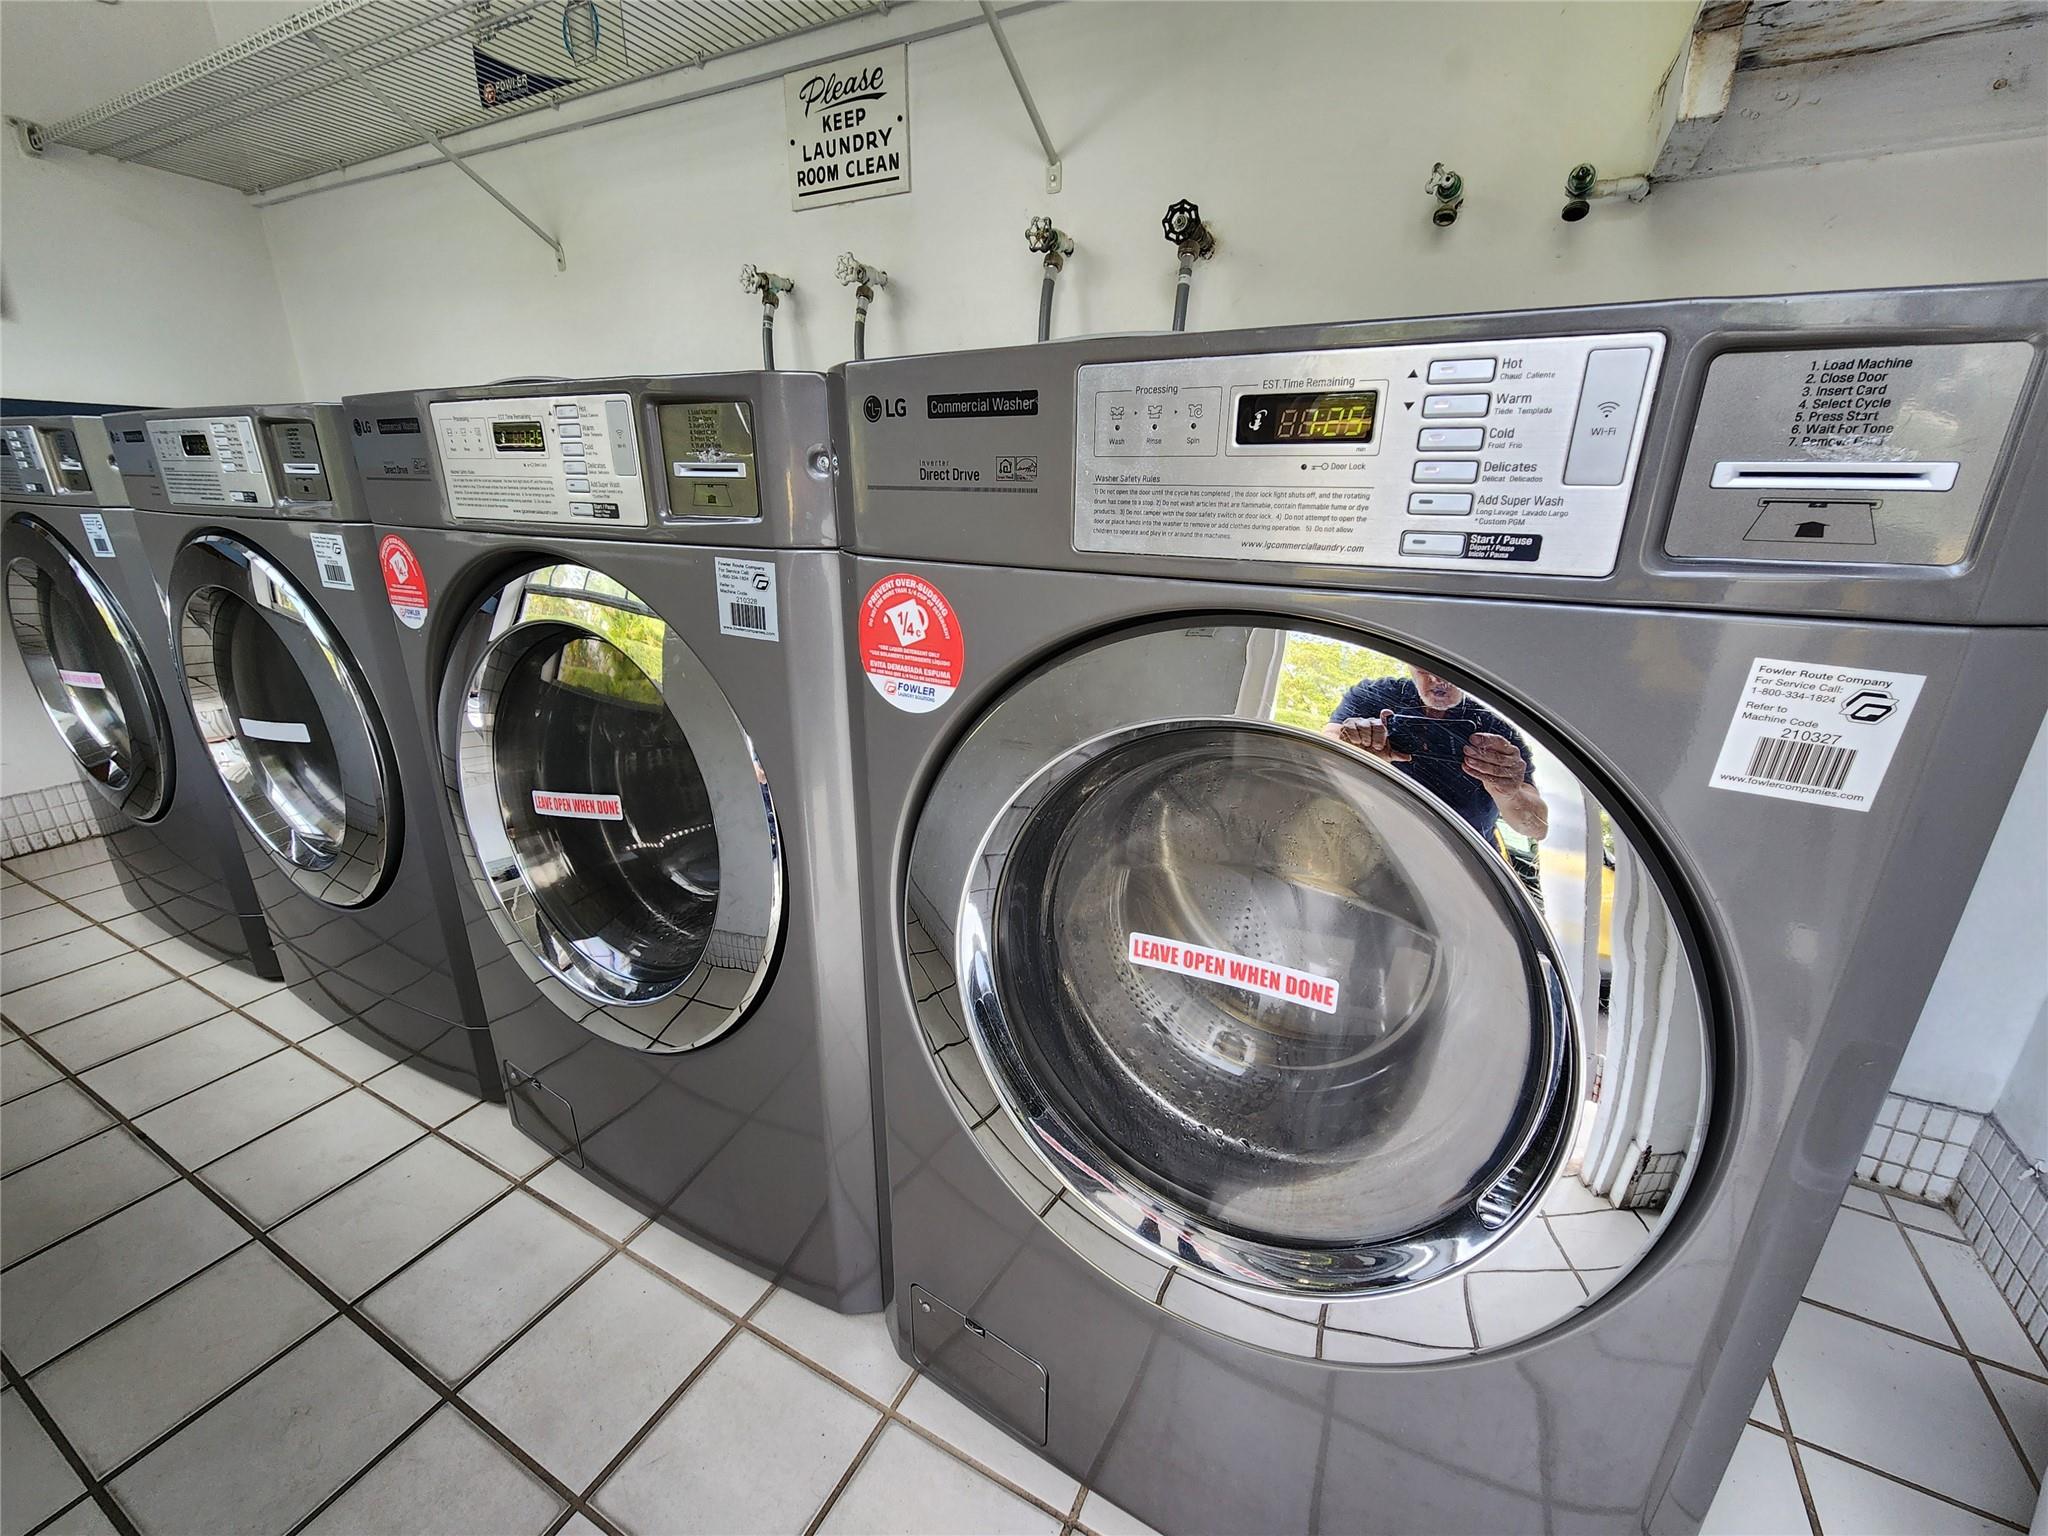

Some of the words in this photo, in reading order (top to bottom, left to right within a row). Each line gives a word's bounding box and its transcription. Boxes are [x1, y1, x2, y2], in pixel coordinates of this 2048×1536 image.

[799, 67, 884, 118] Please
[822, 108, 866, 133] KEEP
[803, 127, 892, 162] LAUNDRY
[798, 164, 839, 187] ROOM
[846, 152, 899, 178] CLEAN
[1502, 358, 1523, 369] Hot
[1811, 361, 1820, 371] 1.
[1823, 360, 1855, 370] Load
[1857, 358, 1913, 369] Machine
[1526, 371, 1556, 379] Caliente
[1805, 374, 1816, 384] 2.
[1820, 373, 1854, 384] Close
[1857, 372, 1888, 382] Door
[1306, 377, 1355, 387] Remaining
[1136, 384, 1178, 395] Processing
[1802, 387, 1812, 396] 3.
[1816, 386, 1853, 396] Insert
[1856, 385, 1887, 395] Card
[1497, 394, 1532, 404] Warm
[1798, 400, 1808, 409] 4.
[1812, 399, 1852, 409] Select
[1856, 398, 1891, 410] Cycle
[886, 398, 906, 417] LG
[931, 399, 989, 414] Commercial
[993, 397, 1033, 411] Washer
[1795, 412, 1804, 422] 5.
[1809, 412, 1843, 421] Press
[1846, 411, 1879, 421] Start
[361, 421, 372, 433] LG
[1489, 428, 1514, 438] Cold
[1591, 427, 1616, 436] Wi-Fi
[1792, 425, 1801, 434] 6.
[1806, 424, 1835, 434] Wait
[1838, 423, 1859, 434] For
[1863, 423, 1894, 434] Tone
[1187, 437, 1200, 445] Spin
[1789, 437, 1798, 447] 7.
[920, 459, 949, 467] Inverter
[1484, 461, 1538, 472] Delicates
[920, 468, 949, 481] Direct
[953, 468, 980, 481] Drive
[1120, 475, 1140, 483] Safety
[1510, 475, 1543, 483] Delicados
[1478, 495, 1499, 505] Add
[1501, 495, 1531, 507] Super
[1534, 496, 1564, 506] Wash
[1357, 504, 1369, 512] dye
[1470, 534, 1494, 544] Start
[1496, 535, 1502, 544] /
[1503, 536, 1533, 545] Pause
[1241, 541, 1364, 553] www.lgcommerciallaundry.com
[868, 580, 894, 608] PREVENT
[895, 578, 948, 617] OVER-SUDSING
[898, 611, 914, 636] 1/4
[870, 660, 886, 668] EVITA
[887, 662, 923, 675] DEMASIADA
[924, 669, 951, 679] ESPUMA
[1759, 665, 1796, 678] Fowler
[1800, 670, 1833, 682] Route
[1836, 674, 1893, 688] Company
[898, 683, 935, 696] FOWLER
[1754, 676, 1773, 686] For
[1776, 678, 1816, 691] Service
[1819, 684, 1844, 694] Call:
[1751, 687, 1837, 704] 1-800-334-1824
[1745, 701, 1773, 712] Refer
[1776, 705, 1788, 714] to
[1742, 712, 1787, 725] Machine
[1790, 718, 1819, 729] Code
[1781, 728, 1842, 745] 210327
[1720, 773, 1864, 802] www.fowlercompanies.com
[535, 796, 553, 810] LEAVE
[554, 797, 571, 811] OPEN
[572, 799, 595, 813] WHEN
[597, 801, 619, 814] DONE
[1134, 939, 1179, 965] LEAVE
[1184, 950, 1226, 977] OPEN
[1230, 962, 1281, 991] WHEN
[1285, 976, 1335, 1006] DONE
